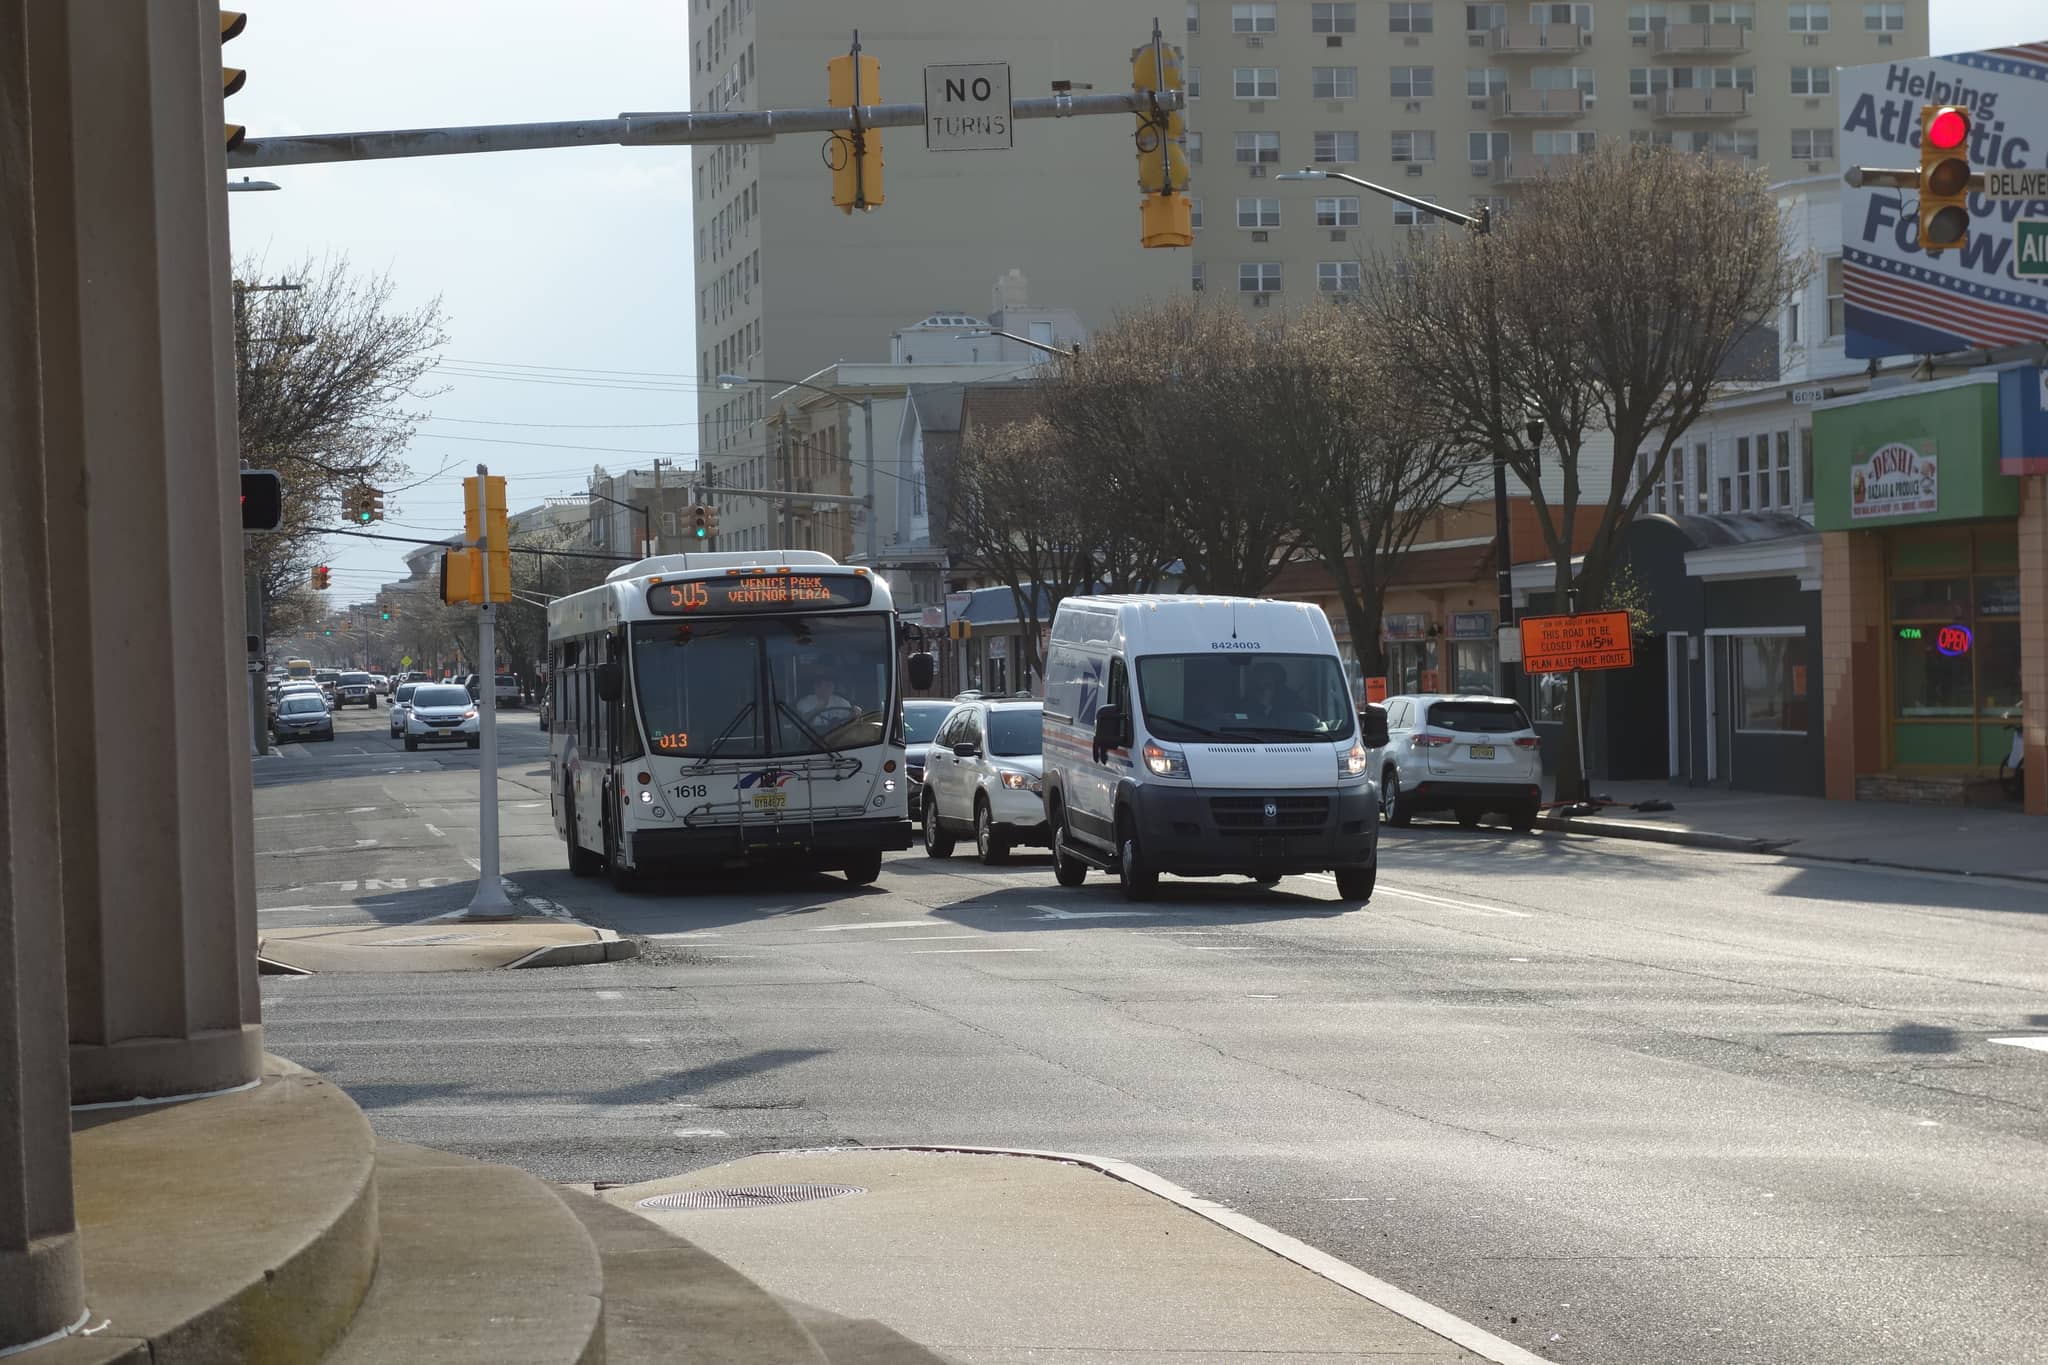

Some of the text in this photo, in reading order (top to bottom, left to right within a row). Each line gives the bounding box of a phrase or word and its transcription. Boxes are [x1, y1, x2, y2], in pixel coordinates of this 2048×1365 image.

[945, 77, 991, 102] NO
[1885, 64, 1999, 121] Helping
[932, 115, 1005, 136] TURNS
[1843, 92, 2030, 169] Atltic
[1990, 174, 2048, 195] DELAYE
[1871, 447, 1914, 481] DESHI
[1895, 480, 1919, 497] PRODUCE
[670, 581, 708, 607] 505
[740, 576, 786, 589] VENICE
[728, 588, 831, 603] VENTNOR PLAZA
[1542, 626, 1611, 640] THIS ROAD TO BE
[1900, 628, 1922, 639] ATM
[1938, 627, 1969, 653] OPEN
[1211, 641, 1261, 650] 8424003
[1541, 641, 1572, 652] CLOSED
[1531, 653, 1625, 669] PLAN ALTERNATE ROUTE
[660, 732, 688, 748] 013
[674, 785, 707, 798] 1618
